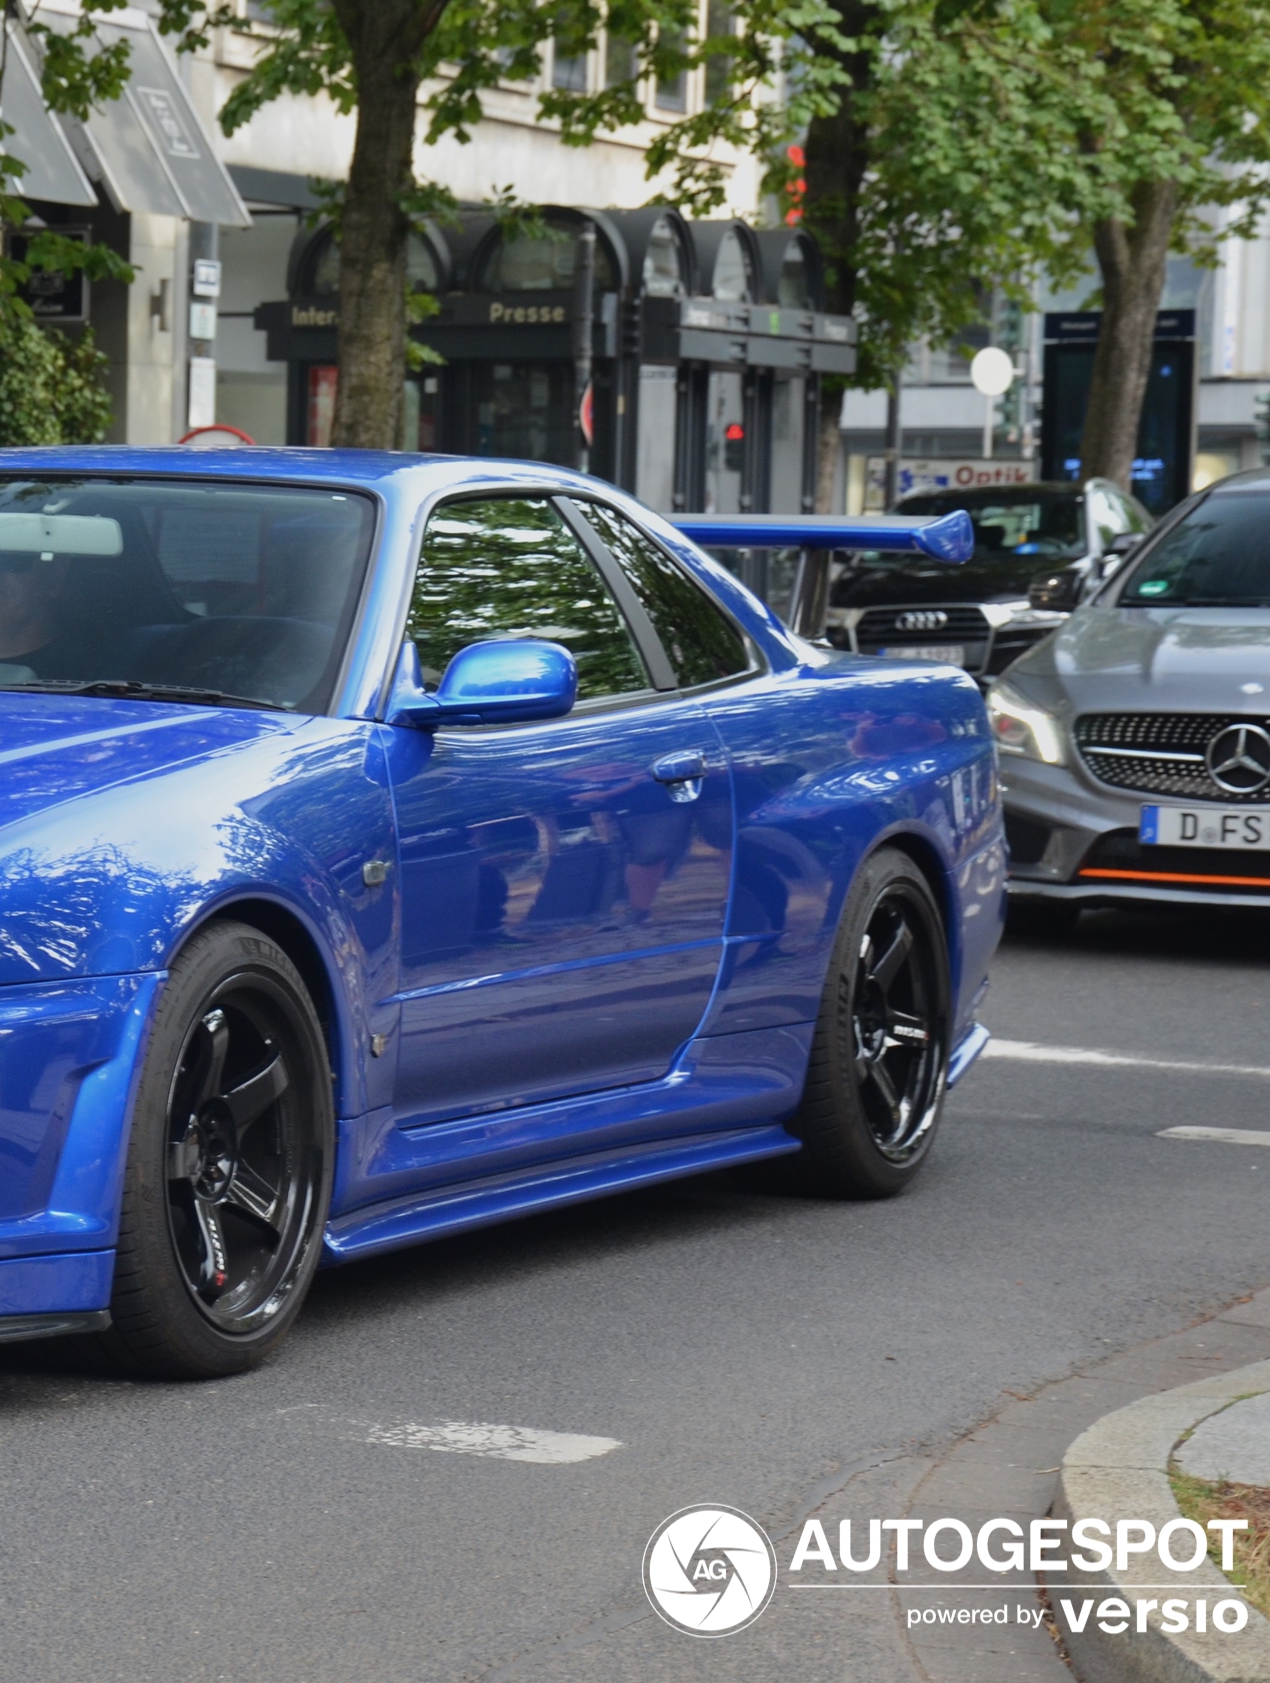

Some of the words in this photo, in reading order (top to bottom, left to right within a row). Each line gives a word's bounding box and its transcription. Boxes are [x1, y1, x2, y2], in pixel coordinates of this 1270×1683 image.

[291, 306, 339, 326] Inter
[489, 302, 566, 323] Presse
[955, 465, 1027, 486] Optik
[1179, 813, 1198, 840] D
[1219, 815, 1262, 844] FS
